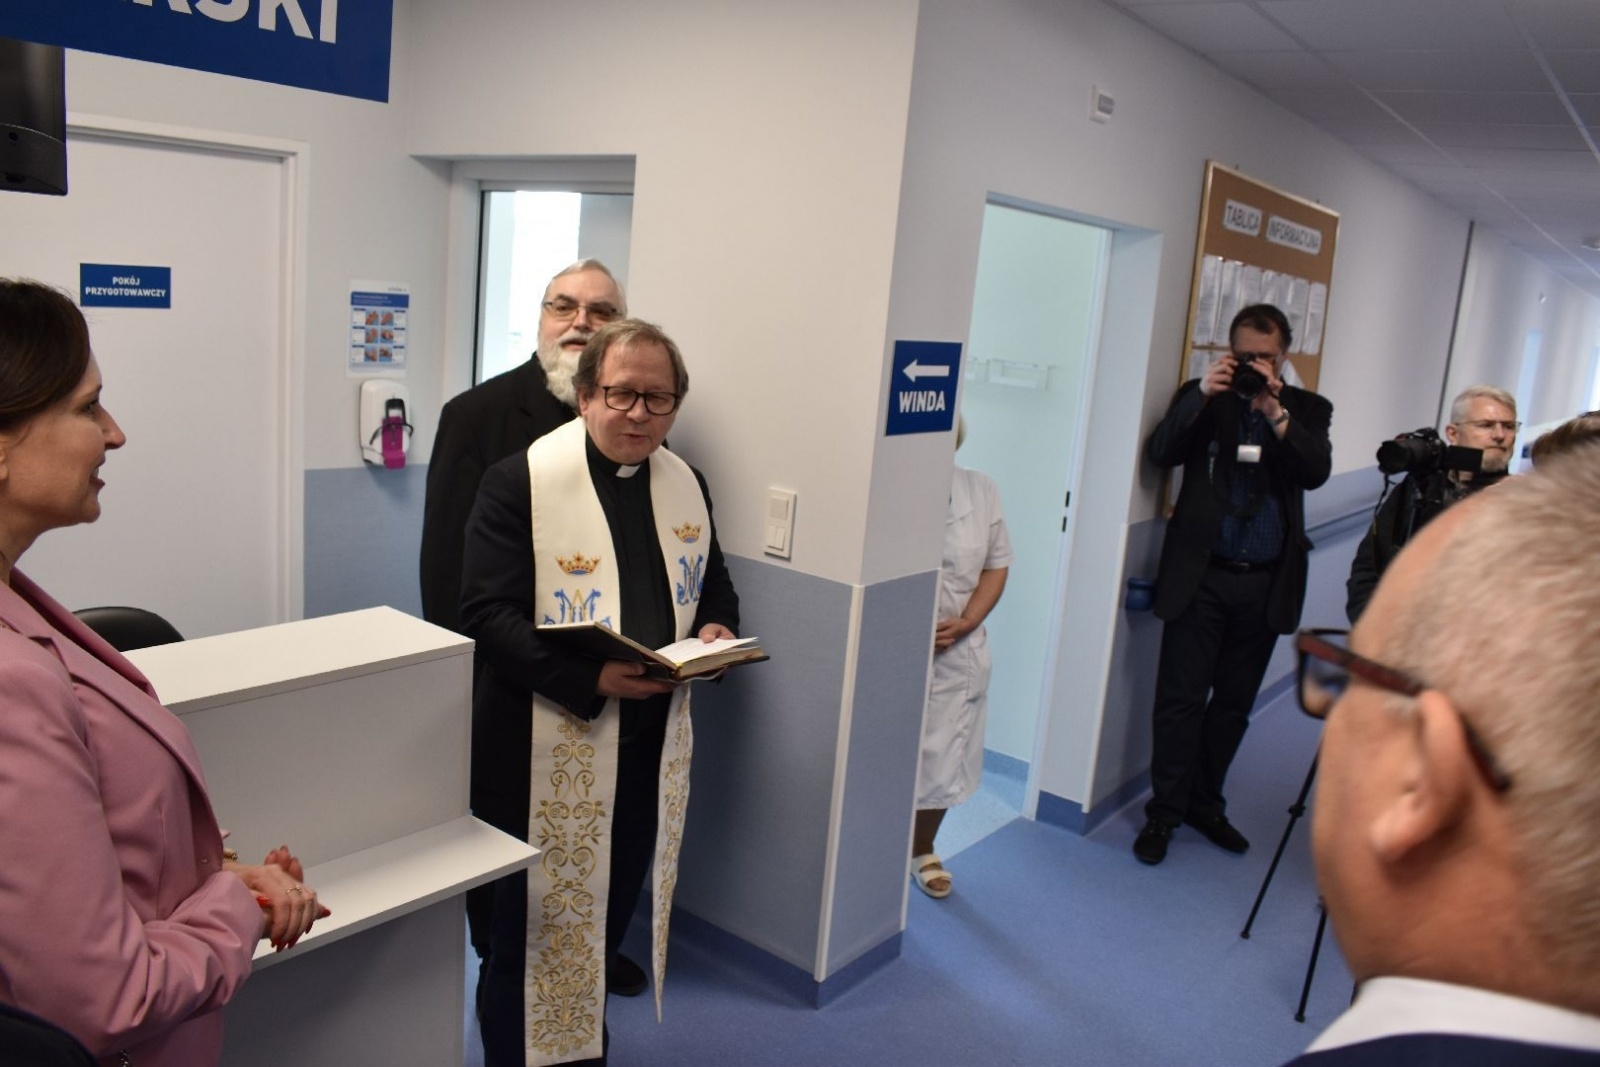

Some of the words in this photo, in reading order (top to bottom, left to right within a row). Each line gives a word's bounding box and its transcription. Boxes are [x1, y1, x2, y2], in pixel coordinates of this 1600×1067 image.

[1226, 205, 1259, 230] TABLICA
[112, 275, 140, 286] POKÓJ
[85, 286, 166, 297] PRZYGOTOWAWCZY
[899, 390, 946, 413] WINDA
